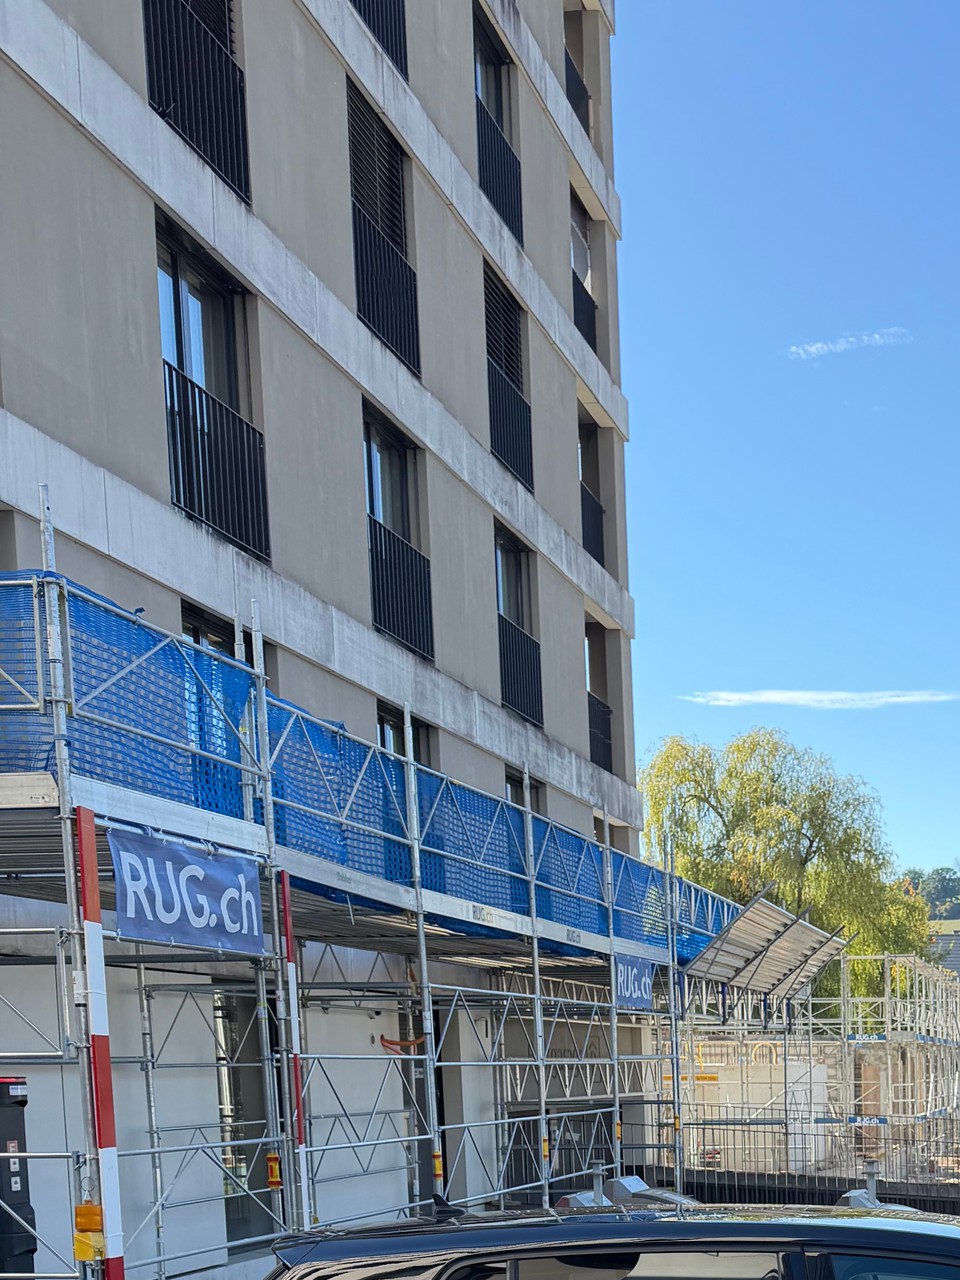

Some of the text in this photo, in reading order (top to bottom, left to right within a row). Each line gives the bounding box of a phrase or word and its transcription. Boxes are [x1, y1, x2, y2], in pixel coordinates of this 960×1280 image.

[119, 850, 259, 936] RUG.ch
[617, 963, 652, 1000] RUG.ch
[855, 1033, 878, 1041] RUG.ch
